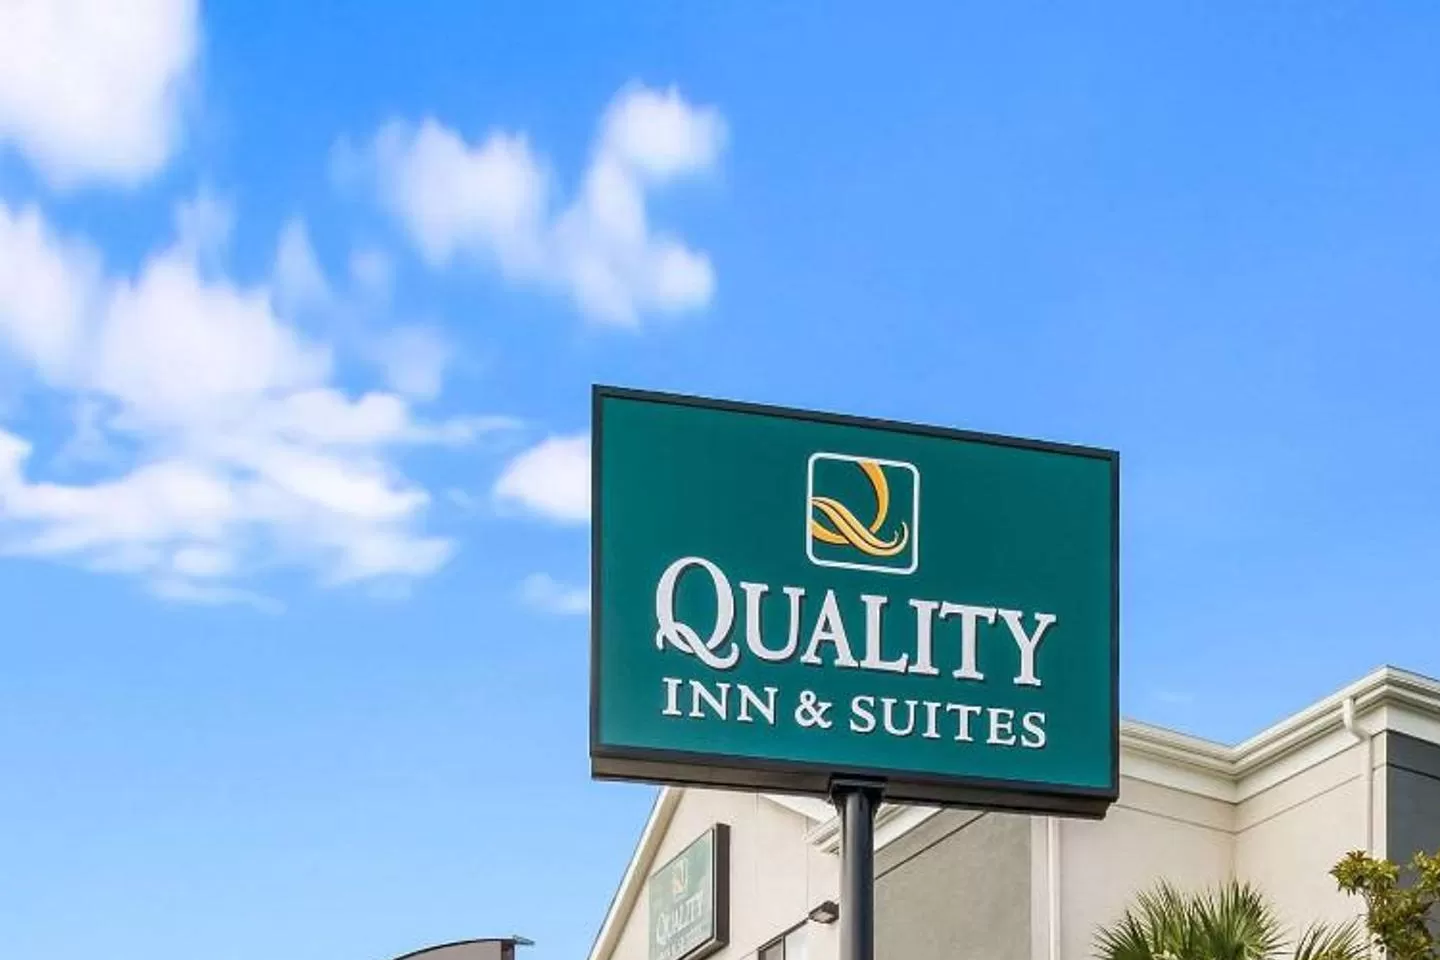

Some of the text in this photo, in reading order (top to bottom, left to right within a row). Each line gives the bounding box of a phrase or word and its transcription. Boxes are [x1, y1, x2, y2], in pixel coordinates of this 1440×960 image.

[656, 556, 1057, 686] QUALITY
[662, 677, 1046, 749] INN & SUITES
